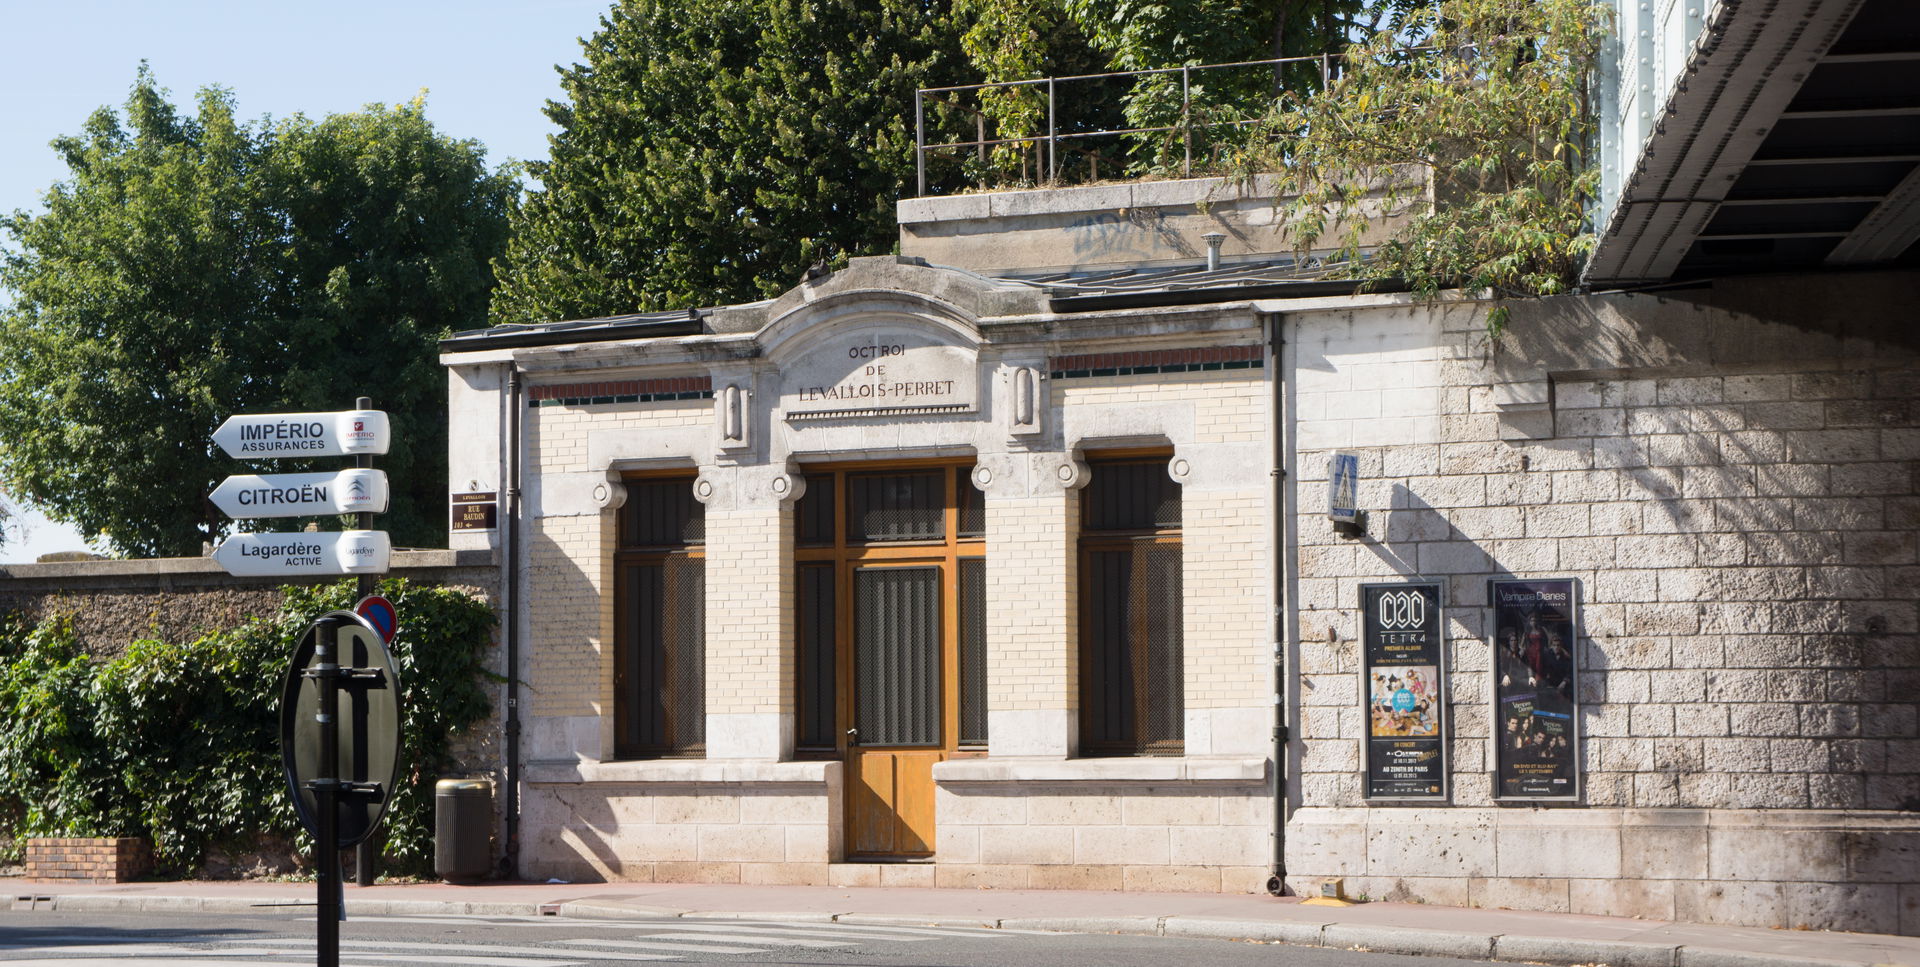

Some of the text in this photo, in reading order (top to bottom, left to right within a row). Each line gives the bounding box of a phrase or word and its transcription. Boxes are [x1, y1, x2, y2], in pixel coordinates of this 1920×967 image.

[849, 345, 905, 358] OCTROI
[866, 365, 886, 376] DE
[800, 380, 955, 401] LEVALLOIS-PERRET
[241, 420, 324, 440] IMPÉRIO
[241, 440, 325, 452] ASSURANCES
[238, 484, 327, 505] CITROËN
[241, 542, 321, 559] Lagardère
[285, 557, 322, 566] ACTIVE
